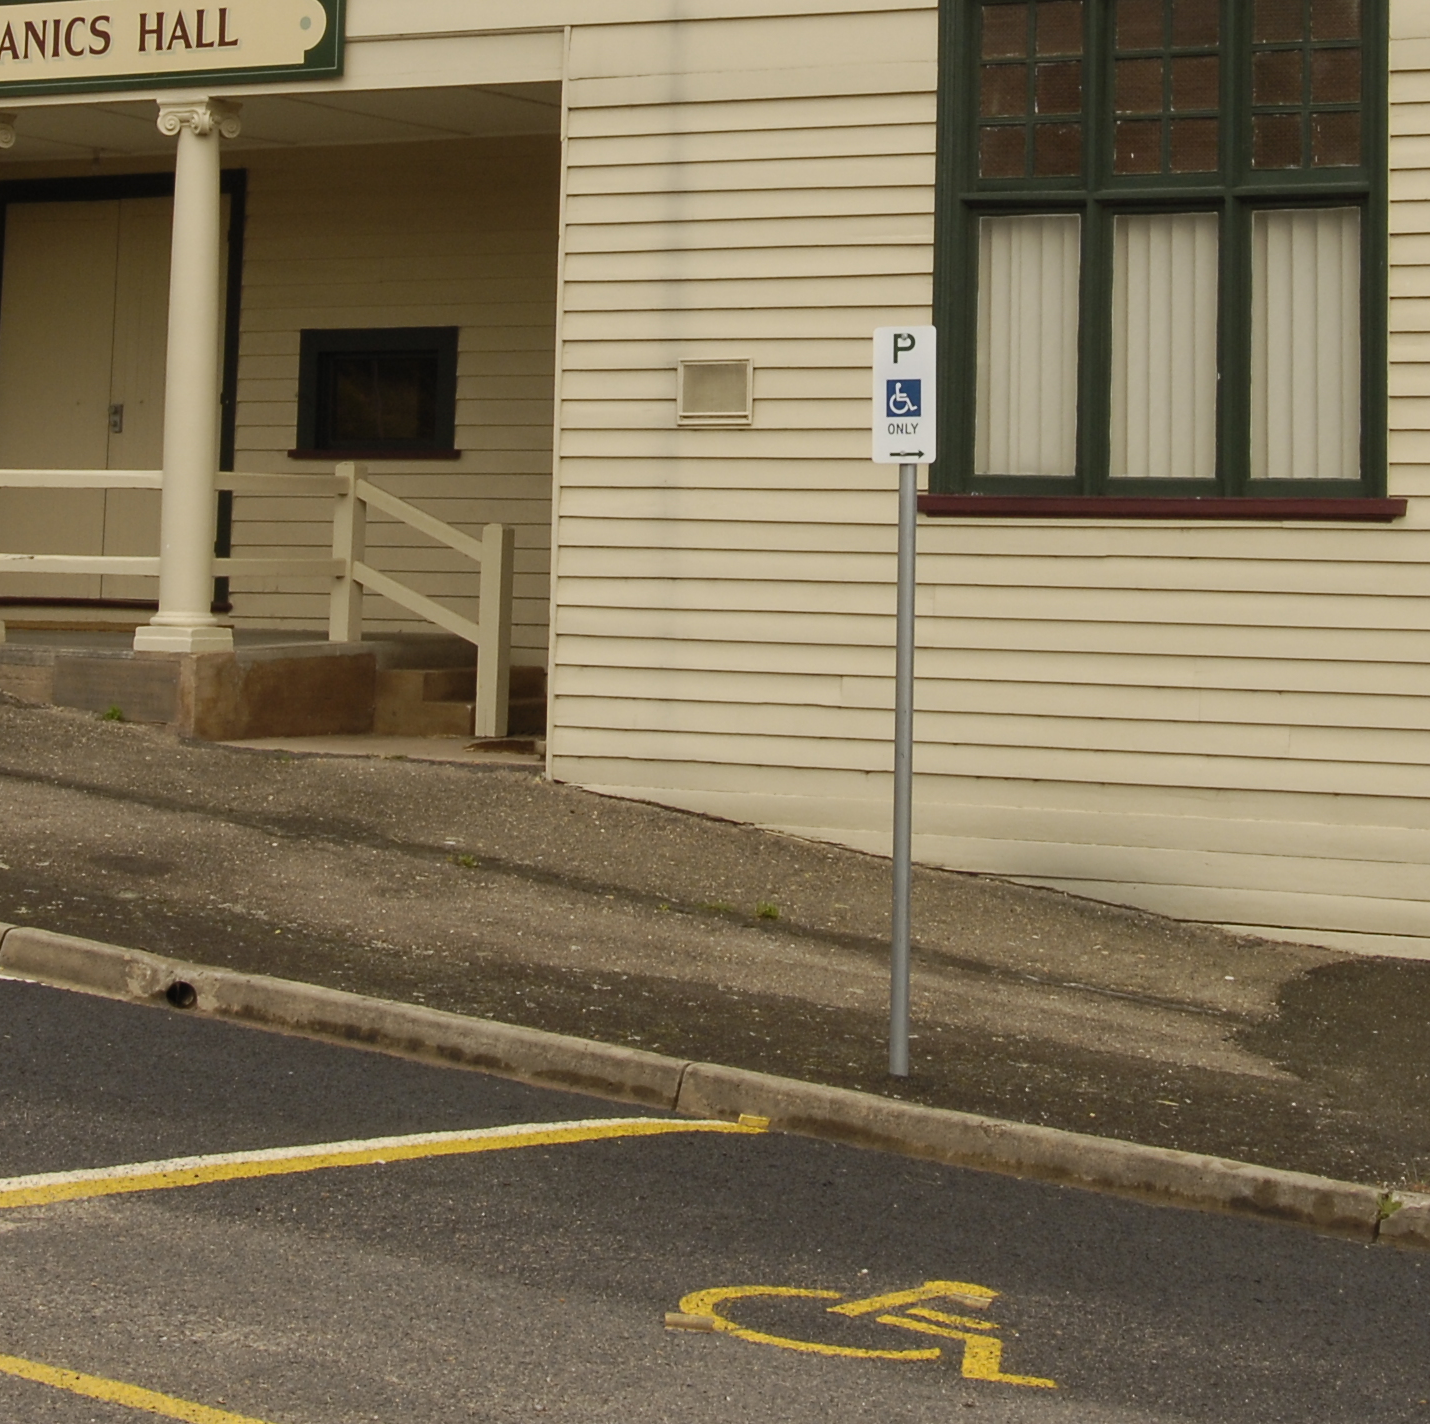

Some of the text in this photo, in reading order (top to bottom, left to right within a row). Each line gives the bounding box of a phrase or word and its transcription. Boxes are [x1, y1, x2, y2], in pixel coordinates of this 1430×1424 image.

[137, 6, 239, 53] HALL
[892, 333, 916, 364] P
[887, 422, 919, 435] ONLY
